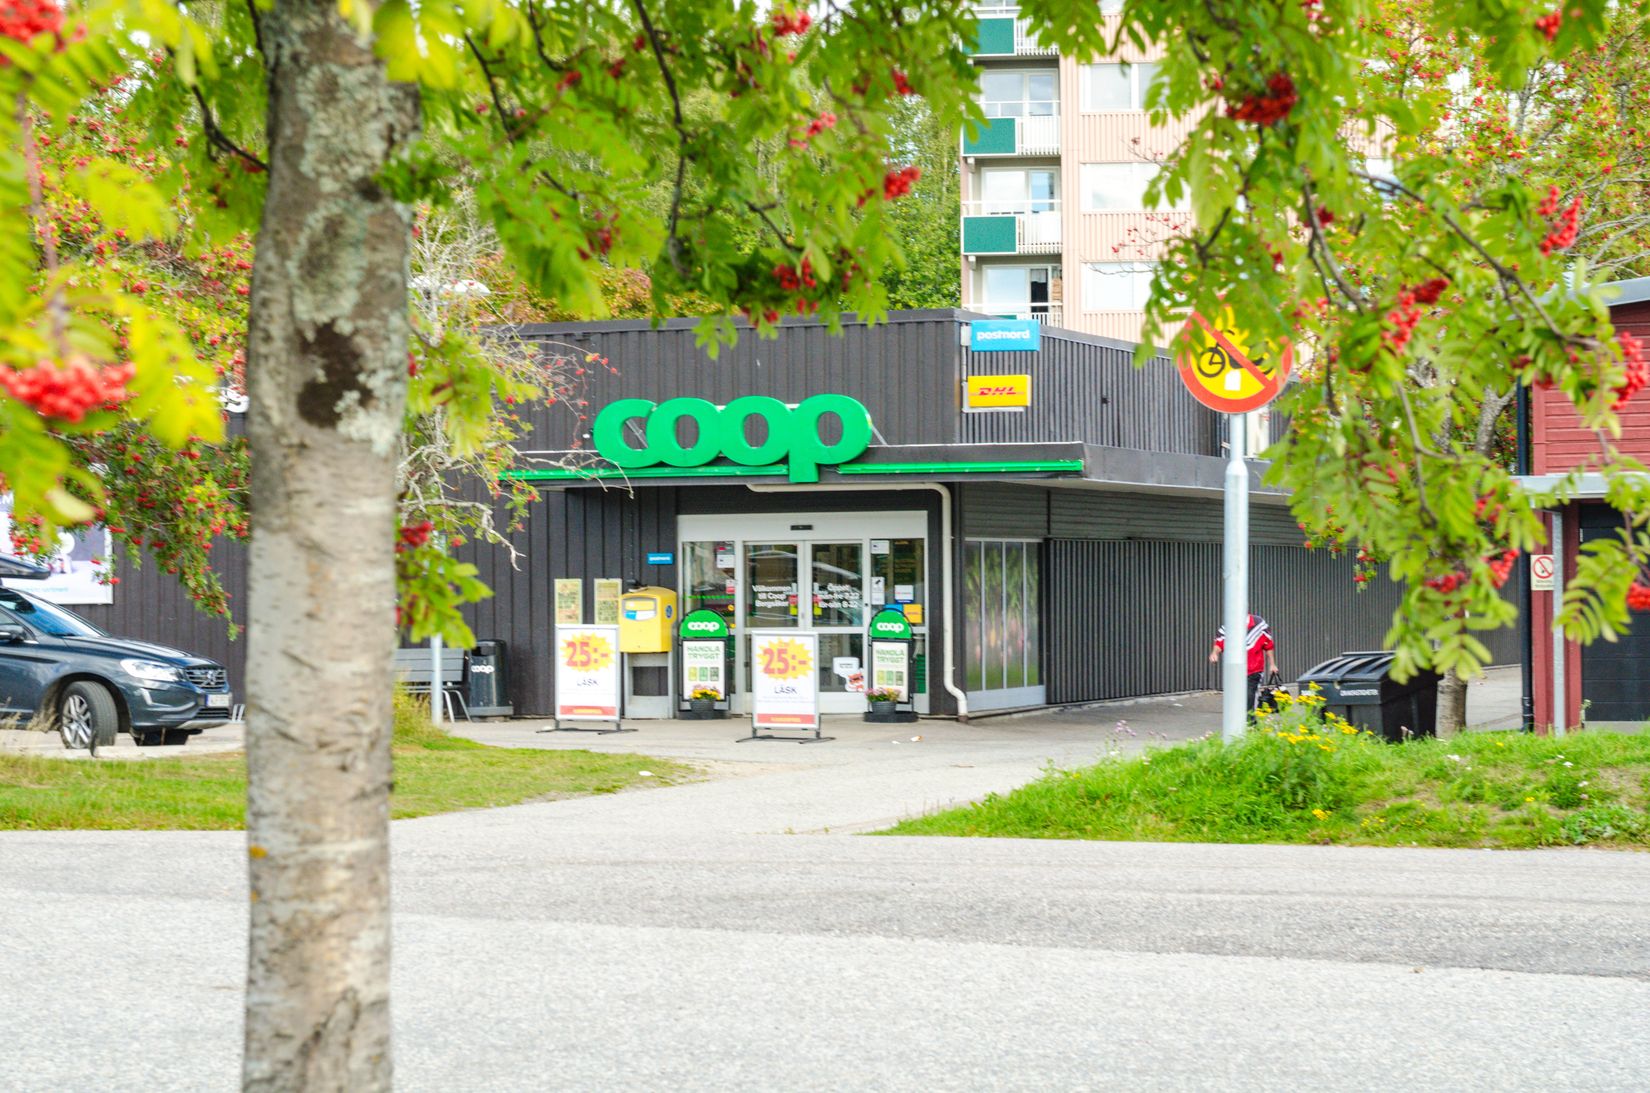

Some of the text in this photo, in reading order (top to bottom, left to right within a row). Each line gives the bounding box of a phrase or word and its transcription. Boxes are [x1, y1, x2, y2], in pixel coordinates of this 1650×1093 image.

[976, 330, 1031, 341] postnord
[978, 387, 1016, 396] DHL
[593, 393, 872, 483] coop
[687, 621, 720, 632] coop
[876, 622, 904, 633] coop
[566, 641, 609, 667] 25:-
[762, 648, 807, 674] 25:-
[471, 665, 495, 674] coop
